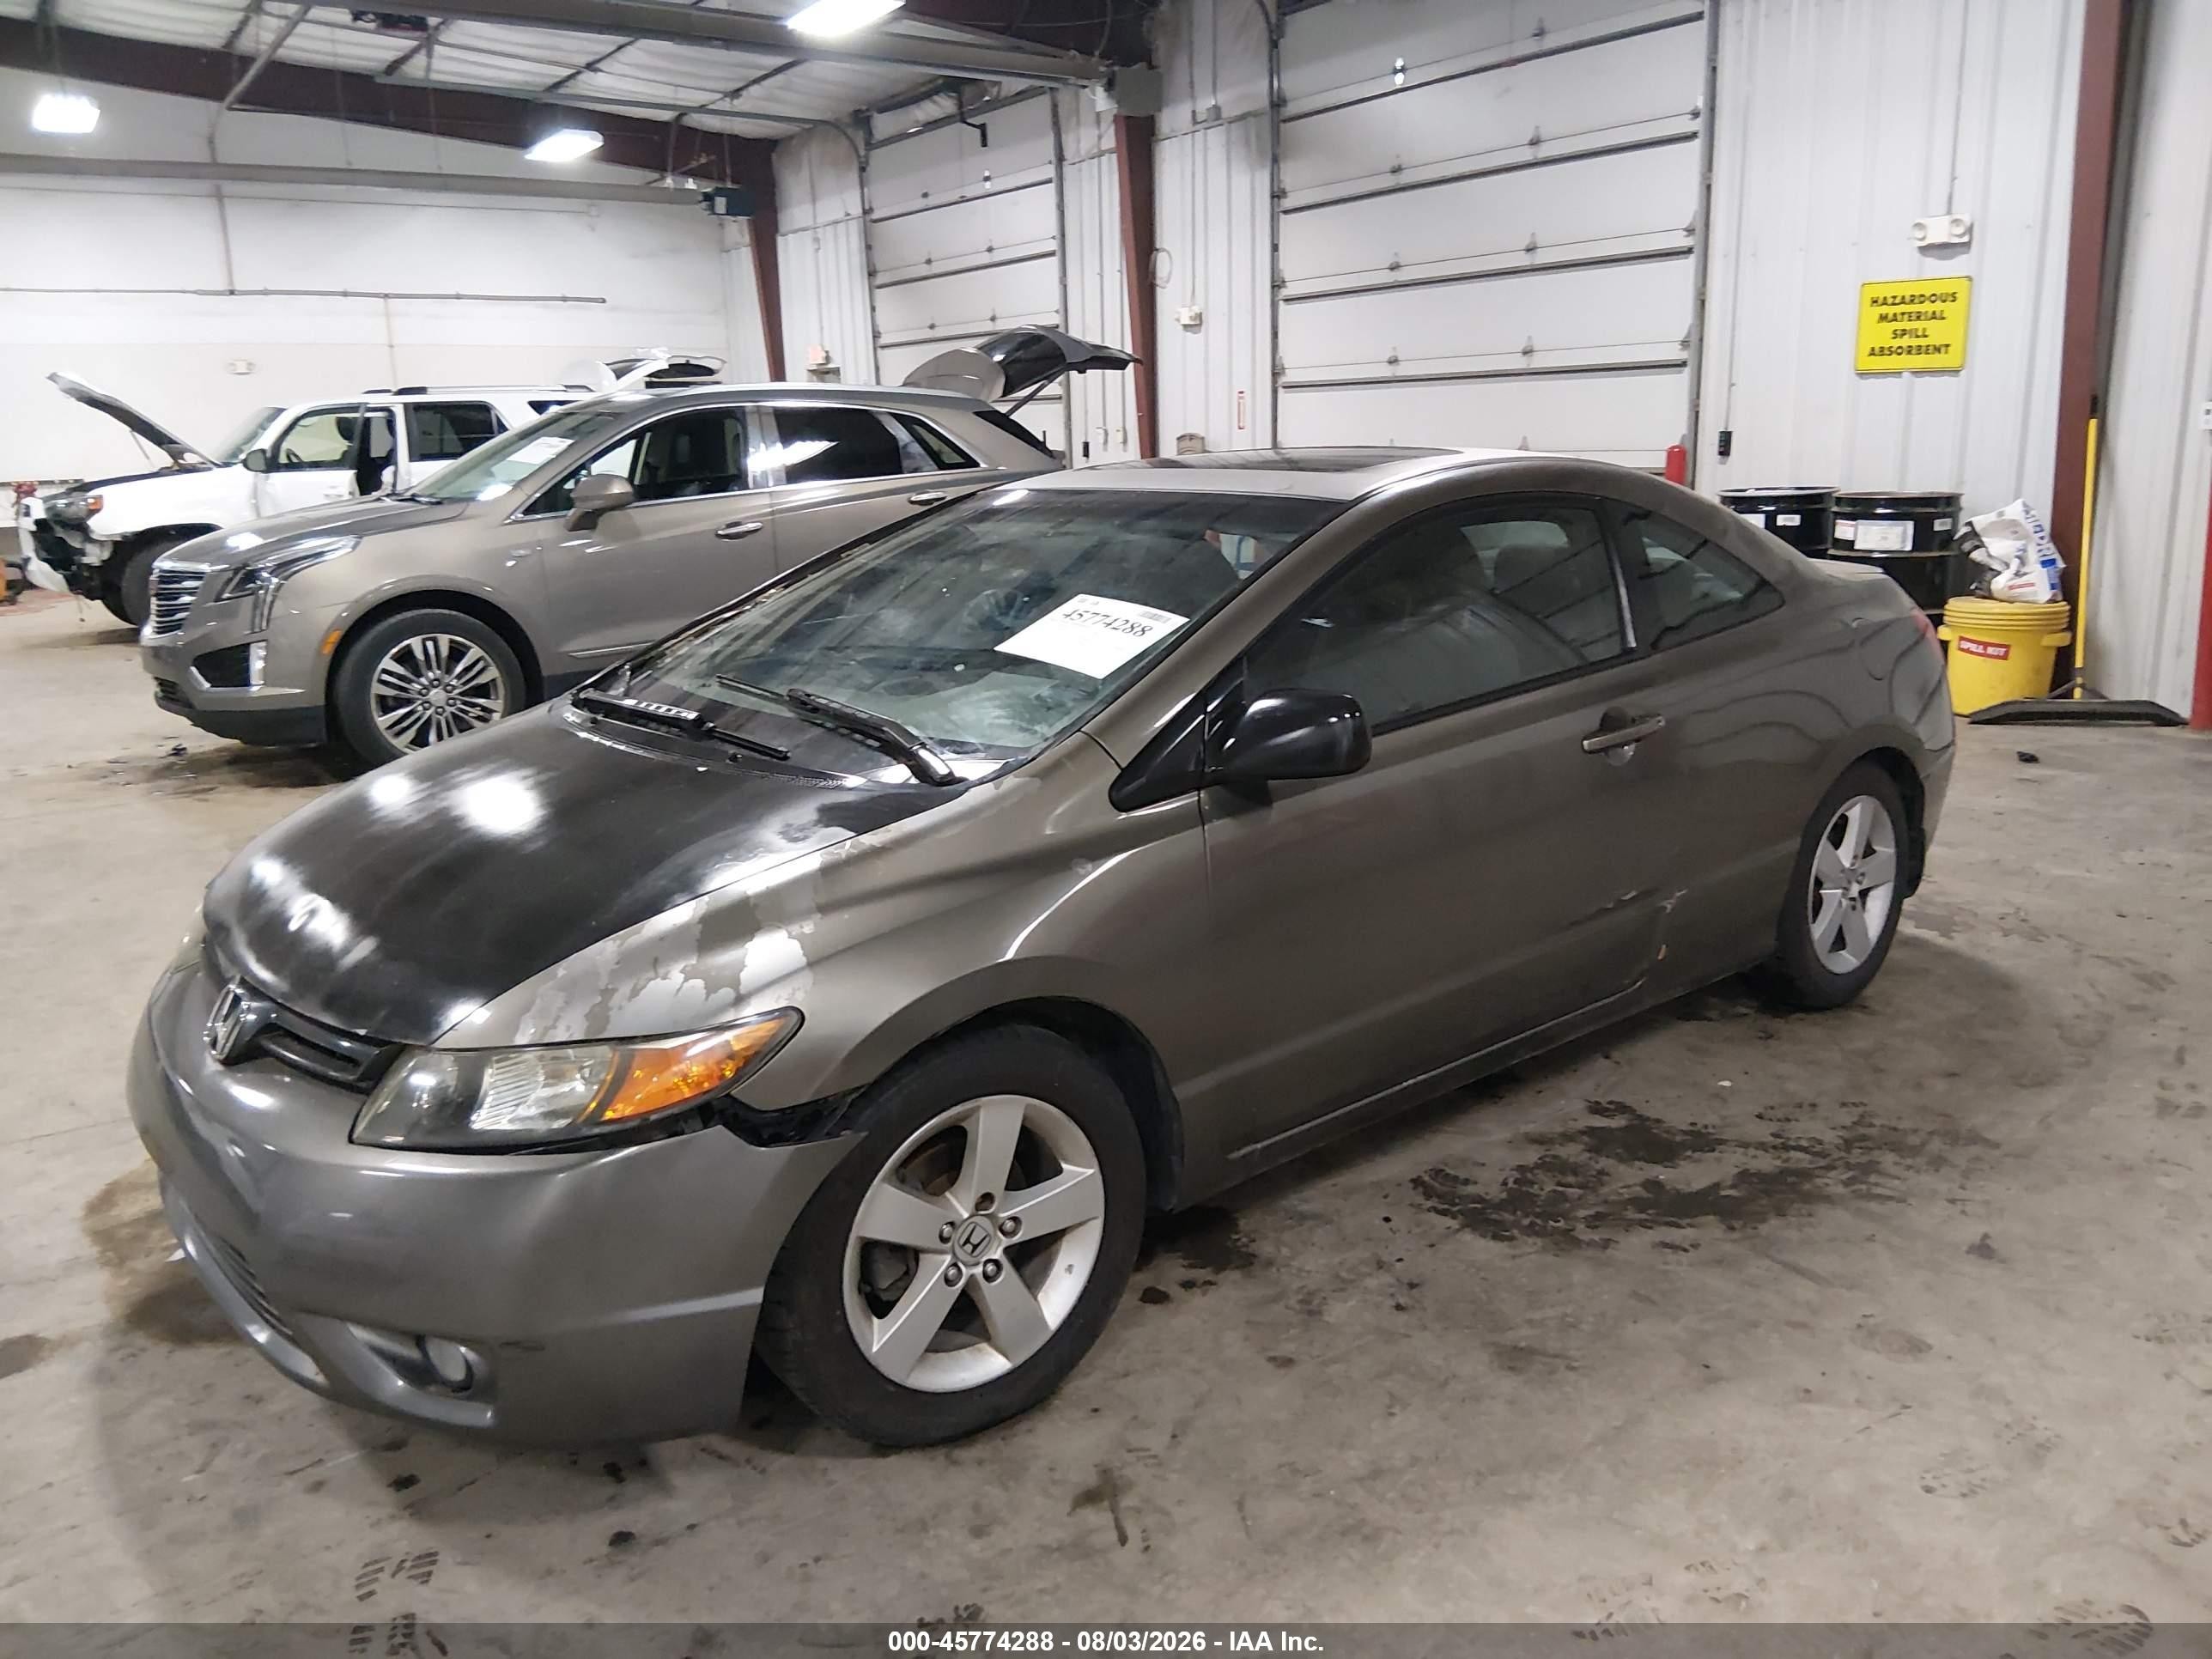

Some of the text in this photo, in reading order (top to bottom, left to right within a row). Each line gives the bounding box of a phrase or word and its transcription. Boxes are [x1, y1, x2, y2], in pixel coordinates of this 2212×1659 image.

[1870, 292, 1958, 307] HAZARDOUS
[1877, 310, 1947, 323] MATERIAL
[1891, 327, 1929, 339] SPILL
[1868, 343, 1951, 356] ABSORBENT
[1062, 609, 1153, 637] 45774288
